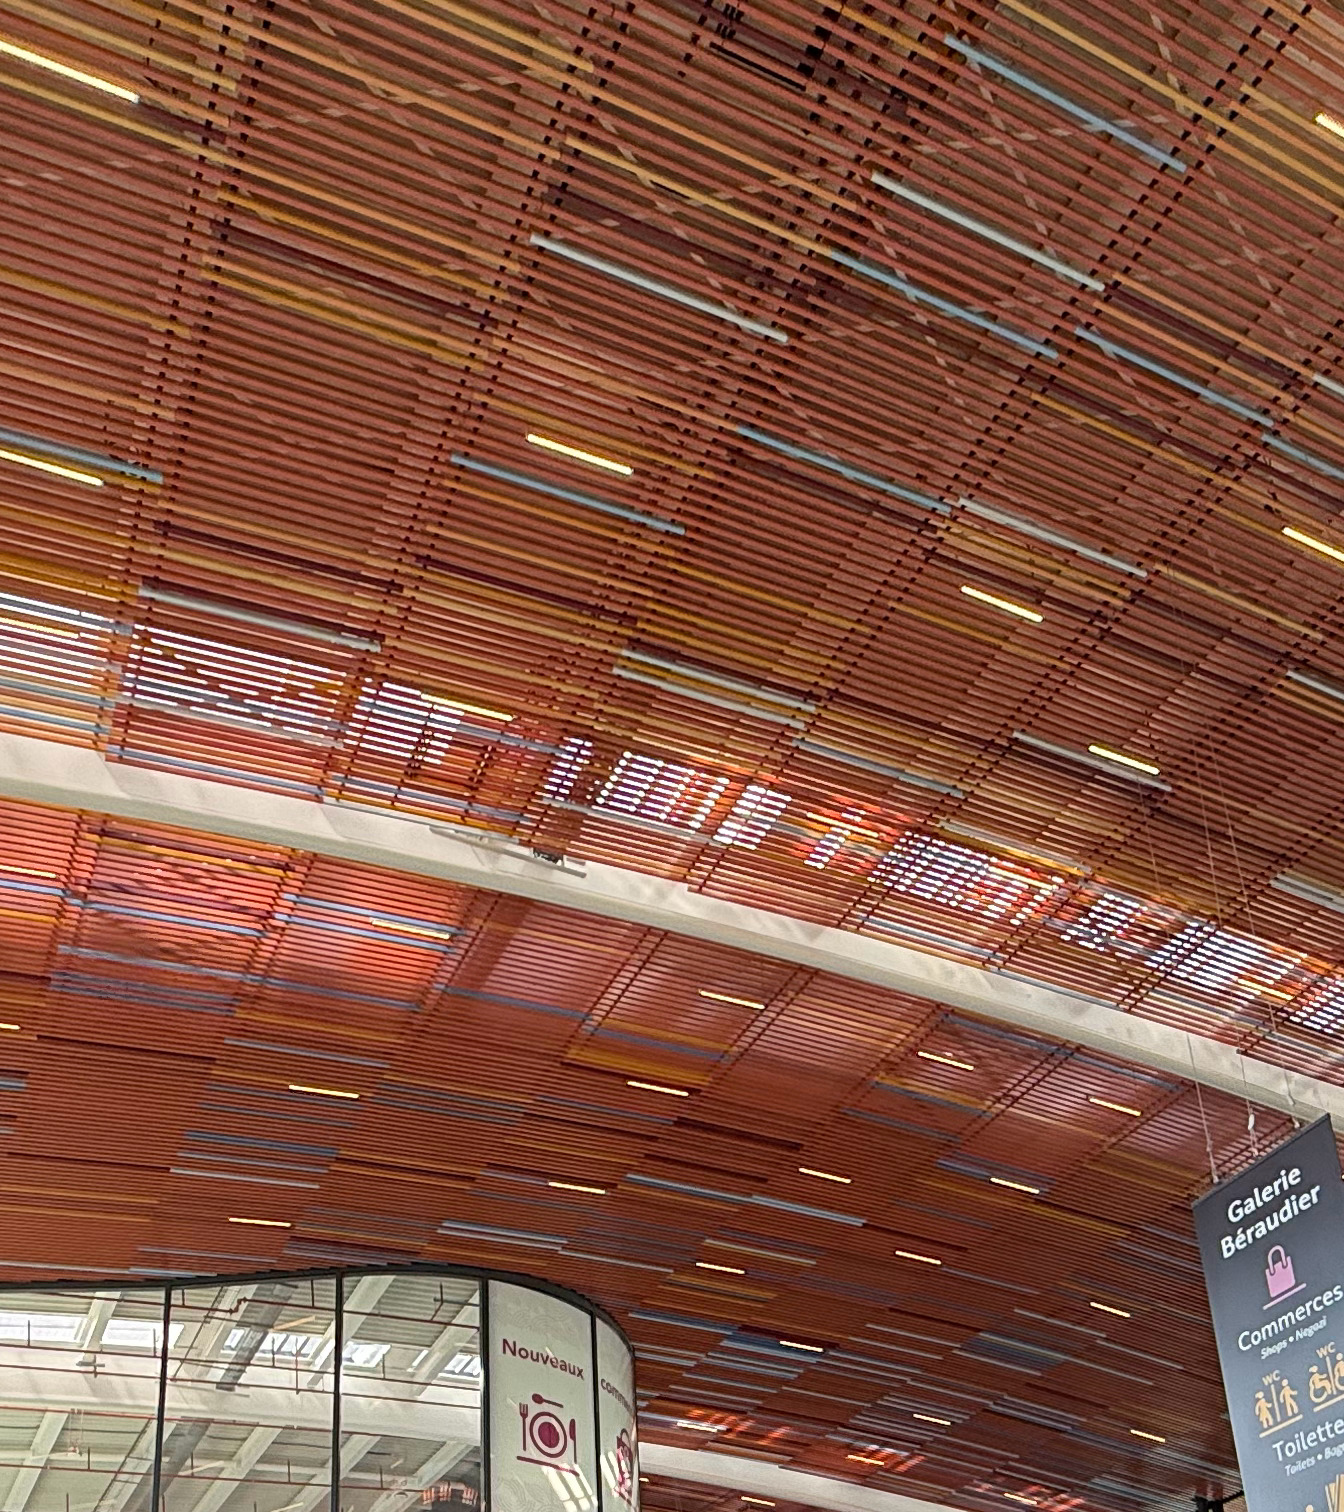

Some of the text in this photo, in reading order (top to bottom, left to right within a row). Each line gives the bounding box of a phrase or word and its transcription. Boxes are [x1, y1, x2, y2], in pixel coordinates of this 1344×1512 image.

[1227, 1167, 1301, 1223] Galerie
[1220, 1185, 1321, 1259] Béraudier
[1238, 1285, 1344, 1351] Commerces
[1261, 1316, 1327, 1360] Shops Negozi
[502, 1338, 585, 1381] Nouveaux
[1316, 1342, 1336, 1359] WC
[1262, 1370, 1281, 1386] WC
[1284, 1457, 1316, 1477] Toilets
